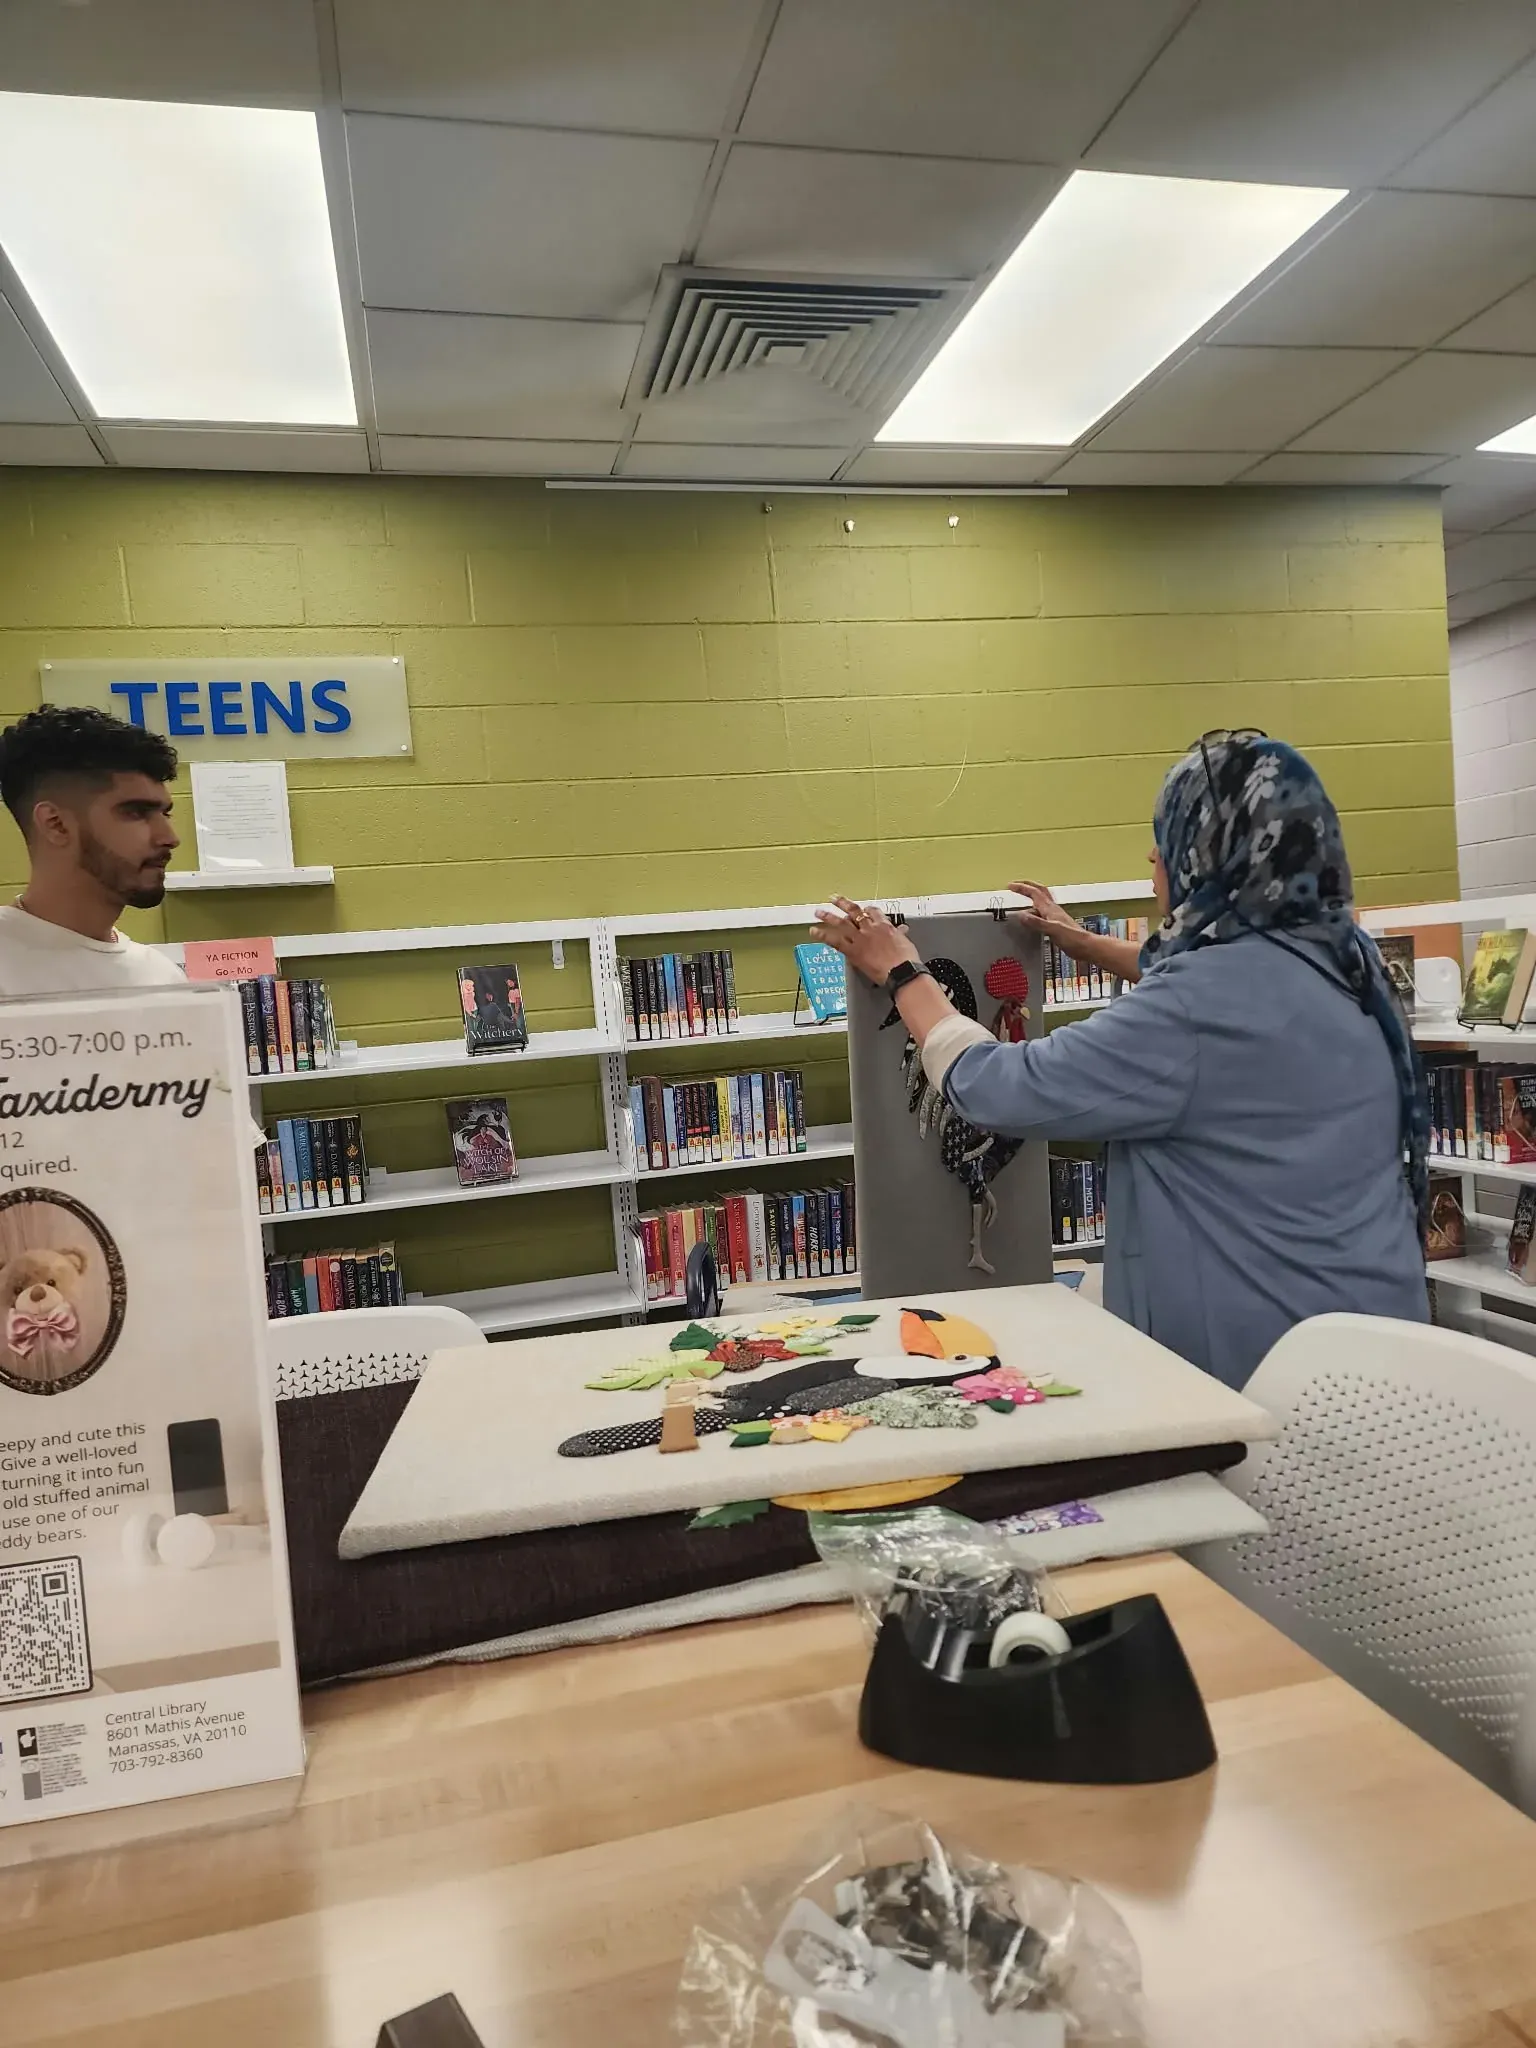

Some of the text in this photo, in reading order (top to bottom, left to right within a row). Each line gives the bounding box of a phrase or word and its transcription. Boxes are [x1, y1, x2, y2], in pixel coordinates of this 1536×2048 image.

[110, 680, 352, 736] TEENS
[206, 951, 259, 962] YA FICTION
[215, 968, 229, 976] Go
[237, 967, 253, 975] Mo
[809, 965, 844, 975] OTHER
[0, 1031, 192, 1059] 5:30-7:00 p.m.
[470, 1028, 523, 1039] Witchery
[0, 1073, 211, 1119] axidermy
[463, 1153, 509, 1167] WOLSIN
[466, 1147, 506, 1158] WITCH OF
[0, 1156, 78, 1182] quired.
[474, 1163, 501, 1174] LAKE
[41, 1431, 72, 1447] and
[77, 1428, 112, 1442] cute
[116, 1423, 146, 1437] this
[1, 1441, 138, 1471] Give a well-loved
[2, 1461, 144, 1491] turning it into fun
[3, 1478, 150, 1510] old stuffed animal
[2, 1503, 119, 1530] use one of our
[0, 1528, 87, 1550] ddy bears.
[105, 1701, 207, 1725] Central Library
[106, 1725, 140, 1742] 8601
[145, 1719, 191, 1736] Mathis
[194, 1711, 245, 1727] Avenue
[109, 1738, 180, 1759] Manassas,
[183, 1732, 202, 1745] VA
[205, 1724, 247, 1743] 20110
[109, 1747, 204, 1774] 703-792-8360
